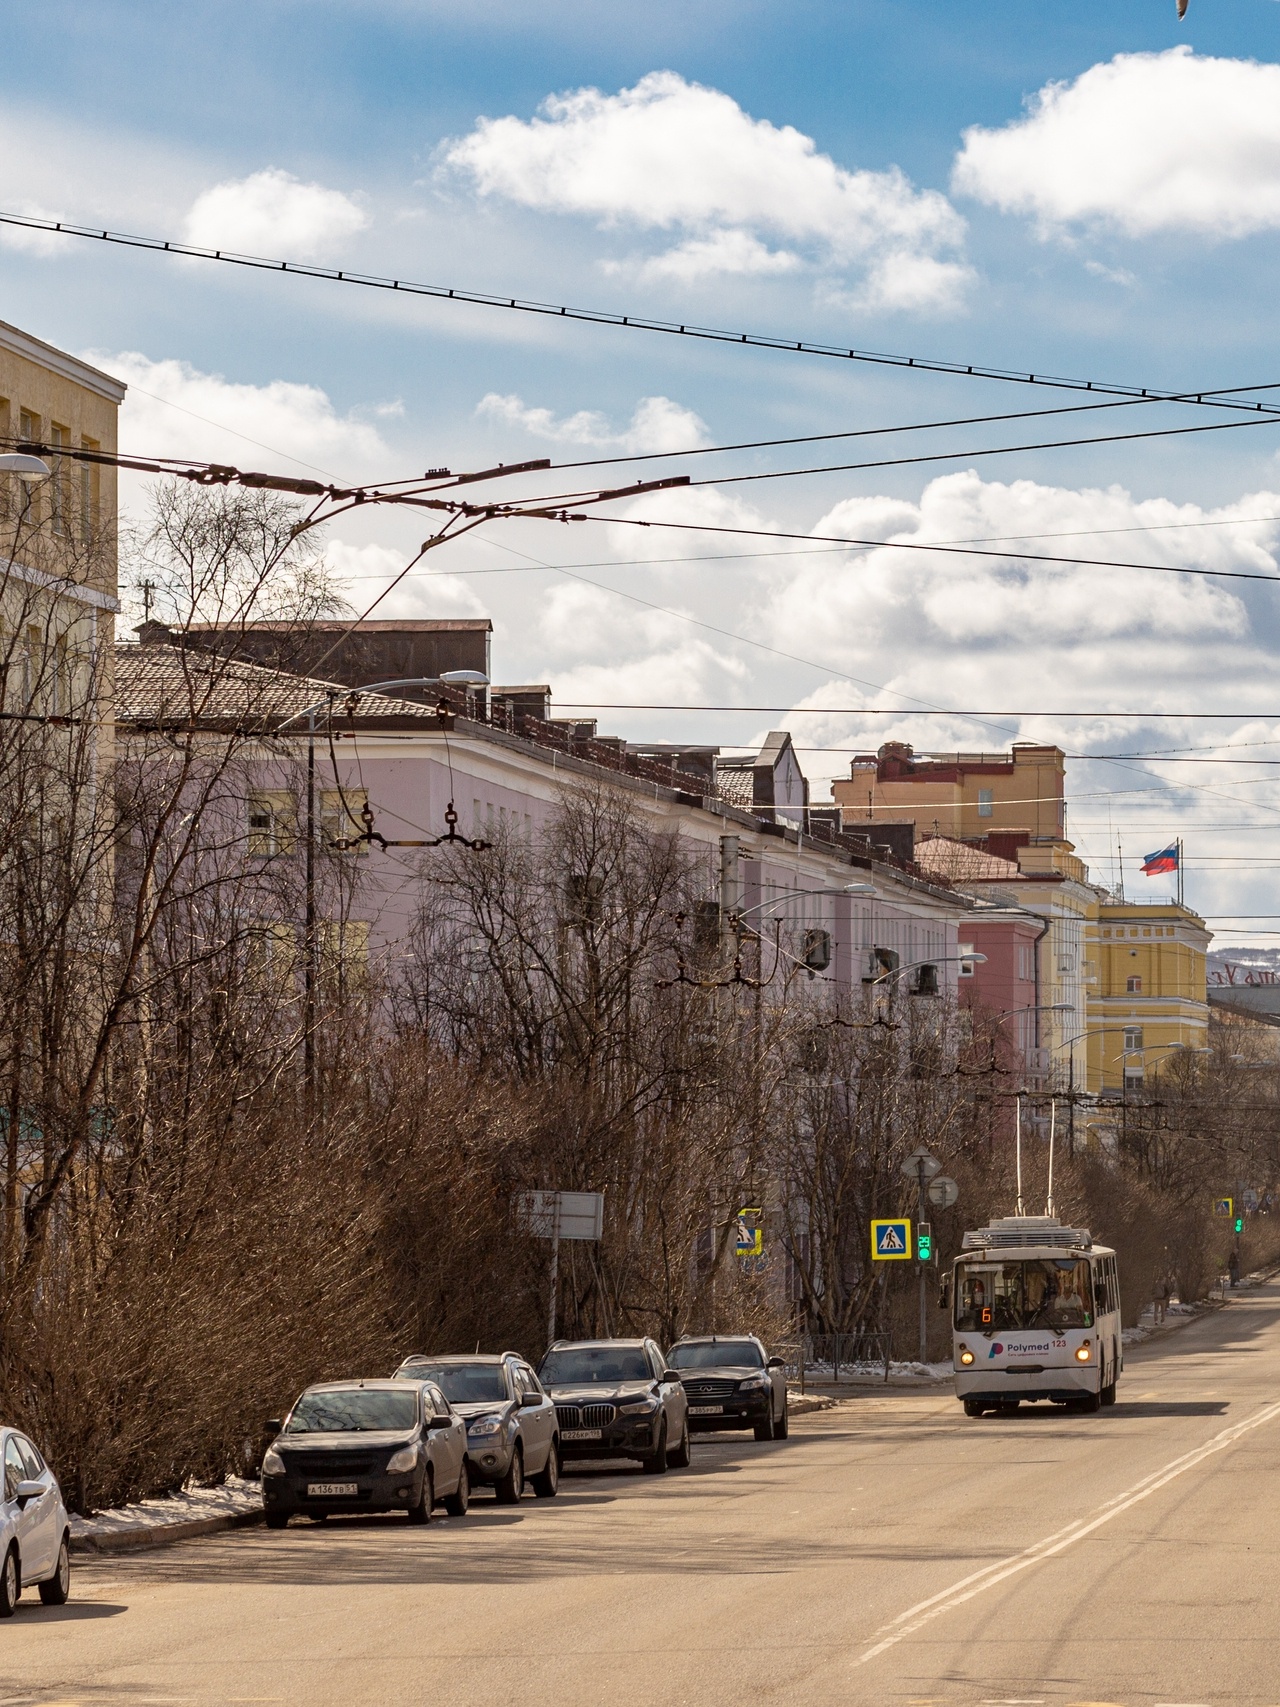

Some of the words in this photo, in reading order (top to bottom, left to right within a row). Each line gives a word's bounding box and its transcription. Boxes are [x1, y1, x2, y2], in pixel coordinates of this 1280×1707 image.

[919, 1237, 930, 1247] 29
[982, 1308, 991, 1323] 6
[1007, 1343, 1050, 1353] Polymed
[1052, 1340, 1067, 1348] 123
